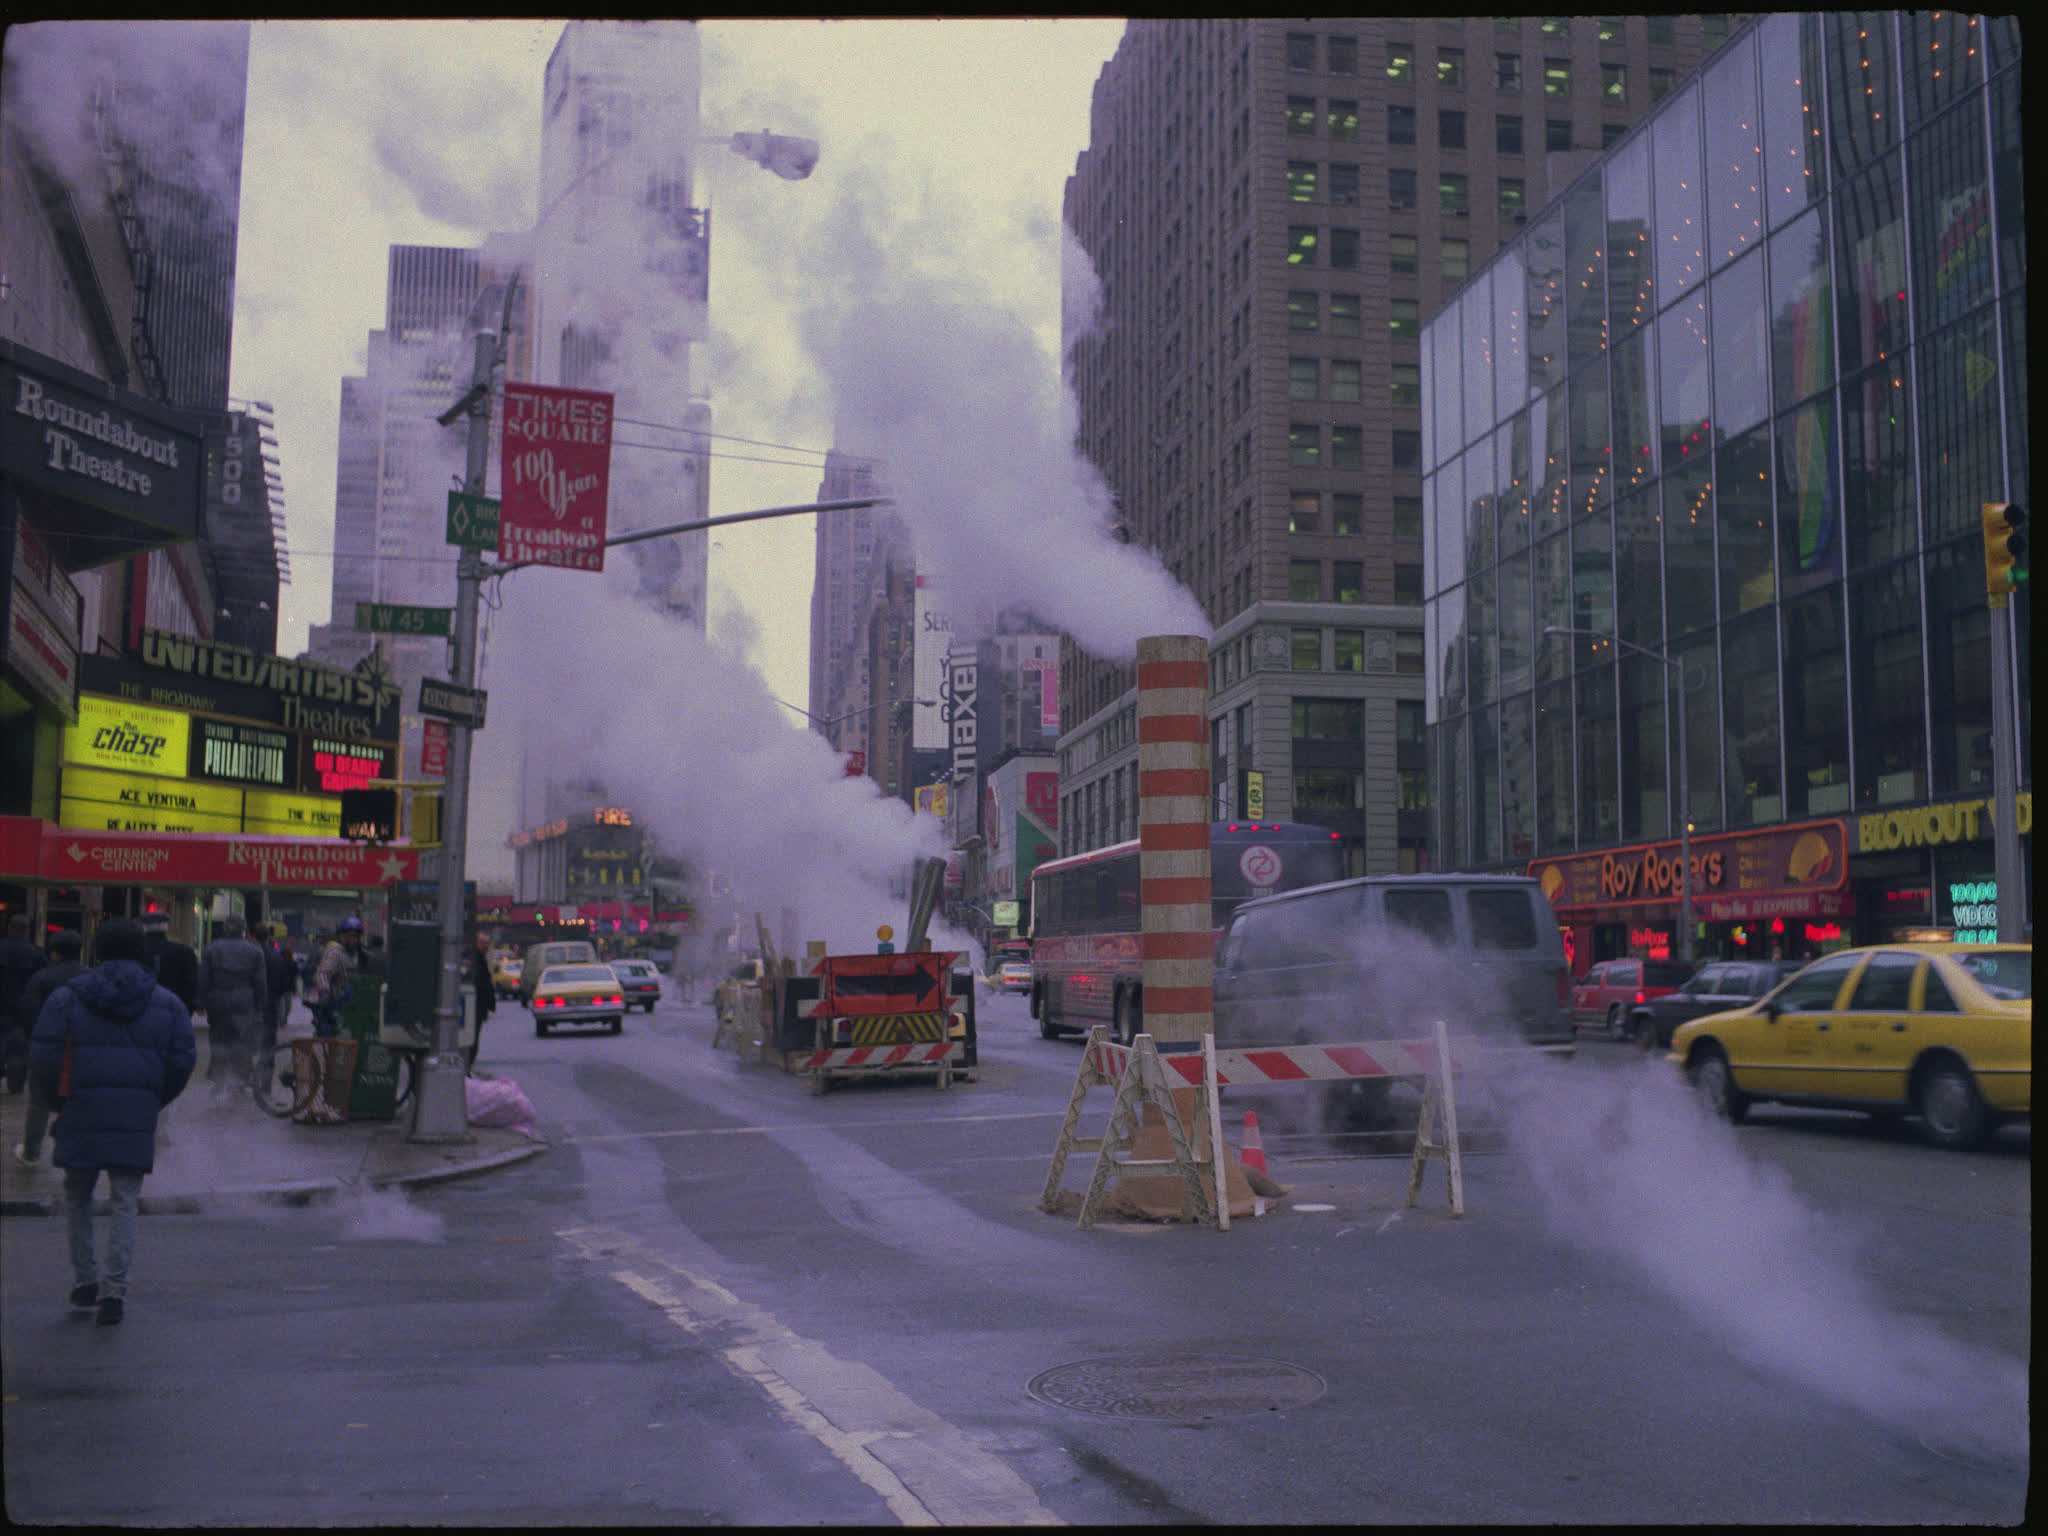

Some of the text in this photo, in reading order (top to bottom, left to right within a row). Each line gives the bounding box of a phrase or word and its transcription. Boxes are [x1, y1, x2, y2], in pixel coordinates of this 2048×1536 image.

[16, 375, 179, 468] Roundabout
[507, 392, 608, 425] TIMES
[507, 417, 607, 445] SQUARE
[45, 428, 153, 496] Theatre
[221, 410, 243, 505] 1500
[474, 503, 500, 521] BIK
[471, 526, 500, 543] LAN
[503, 521, 599, 549] Broadway
[503, 542, 600, 569] Theatre
[377, 607, 393, 629] W
[402, 609, 424, 631] 45
[142, 630, 251, 683] UNITED
[280, 696, 371, 739] Theatres
[204, 737, 284, 785] PHILADELPHIA
[119, 788, 197, 808] ACE VENTURA
[1859, 799, 1985, 852] BLOWOUT
[90, 846, 170, 862] CRITERION
[101, 858, 157, 873] CENTER
[228, 840, 365, 865] Roundabout
[255, 855, 351, 884] Theatre
[1601, 853, 1640, 898] Roy
[1644, 847, 1724, 898] Rogers
